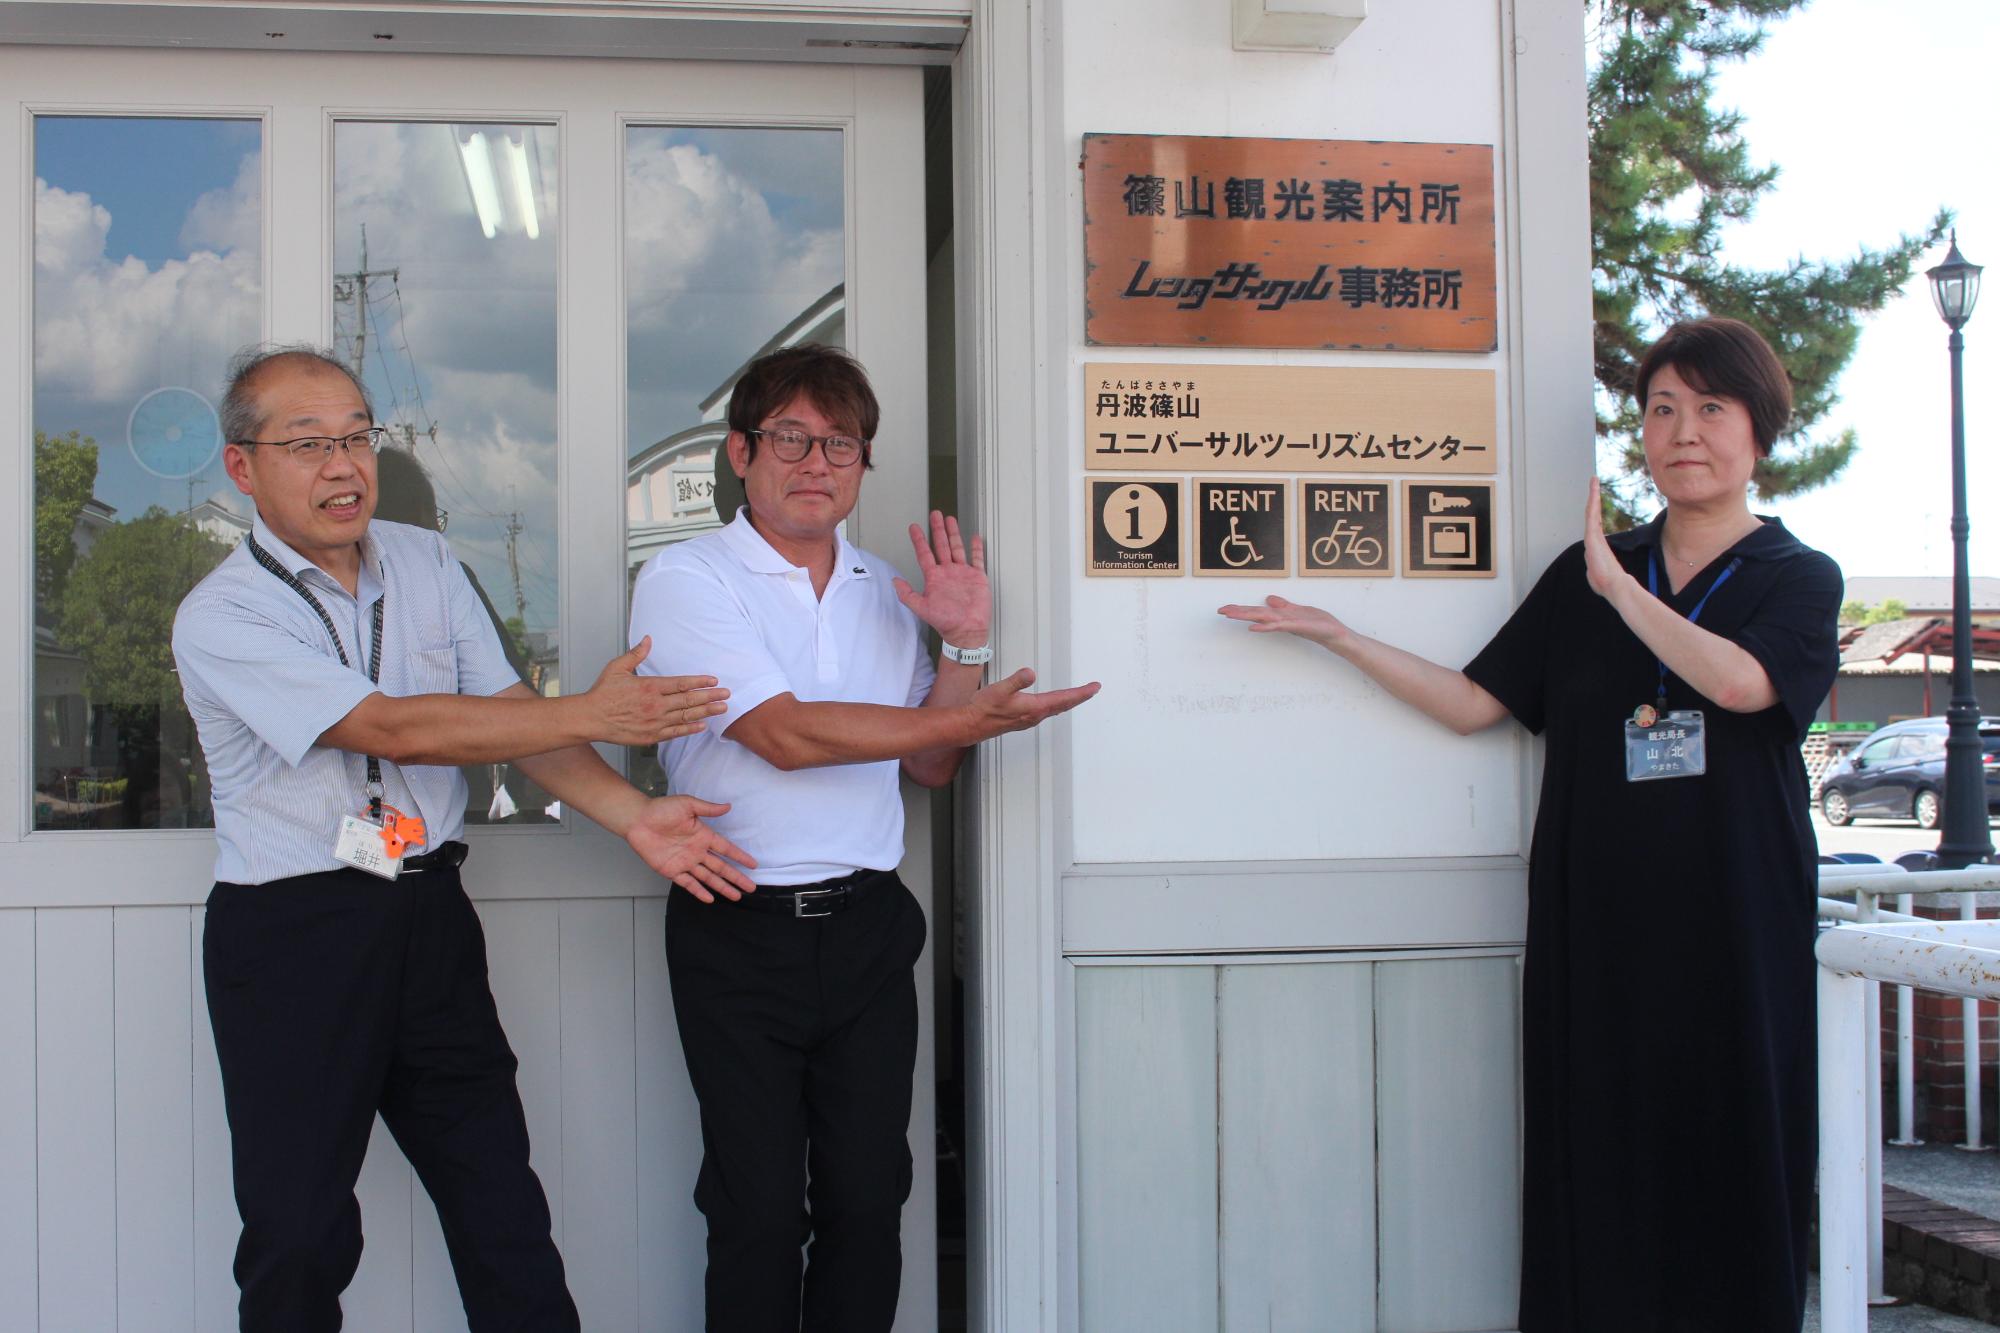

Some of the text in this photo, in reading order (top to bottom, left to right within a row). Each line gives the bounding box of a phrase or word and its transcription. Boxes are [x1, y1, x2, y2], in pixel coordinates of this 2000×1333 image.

[1122, 174, 1462, 224] 篠山観光案内所
[1123, 261, 1462, 310] レンタサイクル事務所
[1101, 380, 1196, 391] たんばささやま
[1096, 393, 1200, 419] 丹波篠山
[1096, 431, 1487, 461] ユニバーサルツーリズムセンター
[1209, 490, 1276, 511] RENT
[1314, 490, 1380, 512] RENT
[1093, 560, 1177, 569] Information Center
[1117, 551, 1153, 560] Tourism
[354, 848, 380, 869] 堀井
